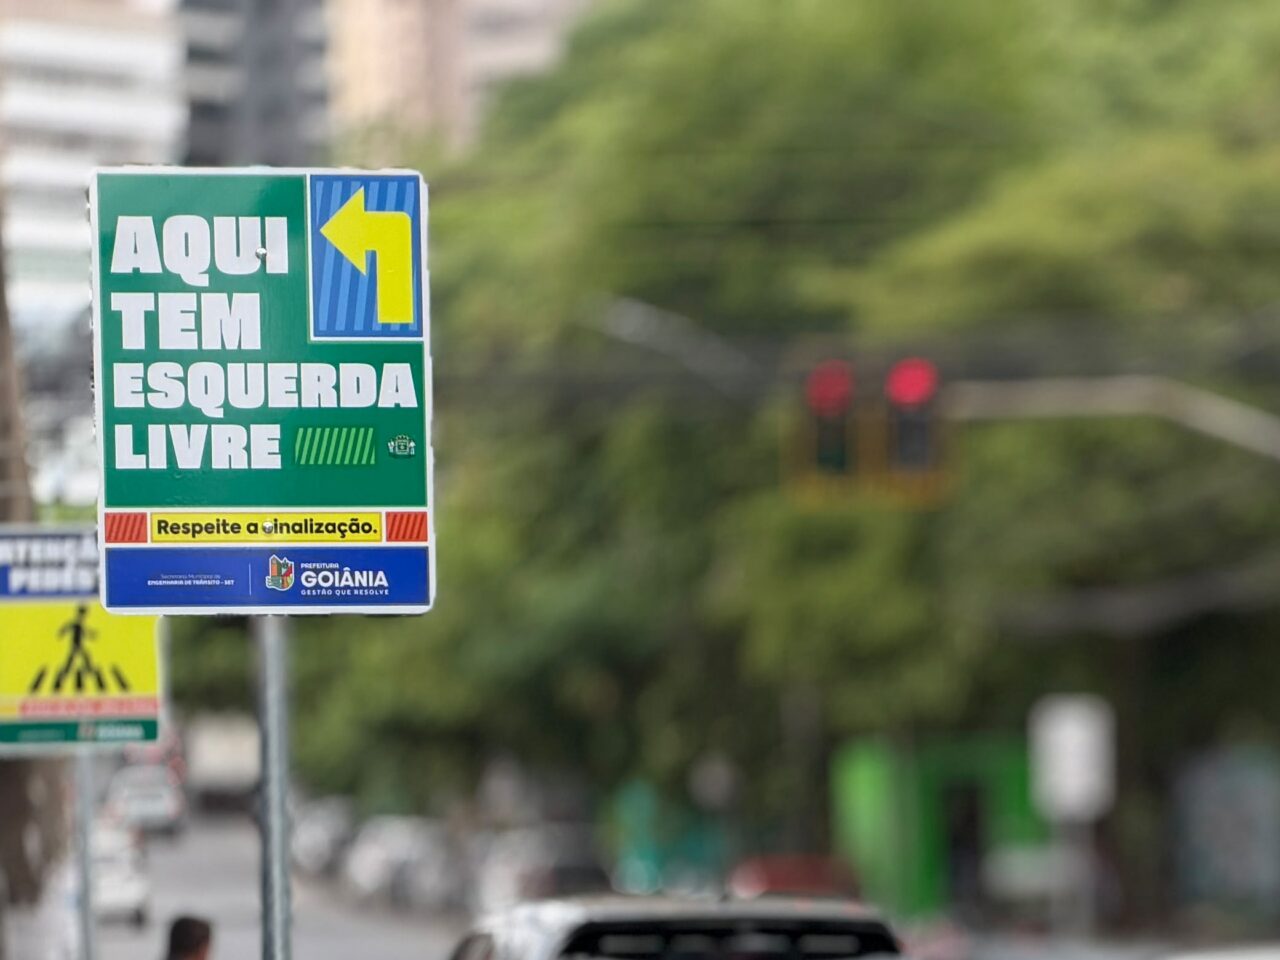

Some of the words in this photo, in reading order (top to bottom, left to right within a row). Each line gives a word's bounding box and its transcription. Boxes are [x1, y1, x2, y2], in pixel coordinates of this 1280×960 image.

[110, 215, 289, 287] AQUI
[110, 292, 262, 350] TEM
[113, 362, 419, 418] ESQUERDA
[114, 424, 282, 470] LIVRE
[157, 518, 242, 539] Respeite
[246, 522, 259, 534] a
[262, 518, 378, 539] inalização.
[300, 566, 389, 588] GOIÂNIA
[300, 588, 333, 596] GESTÃO
